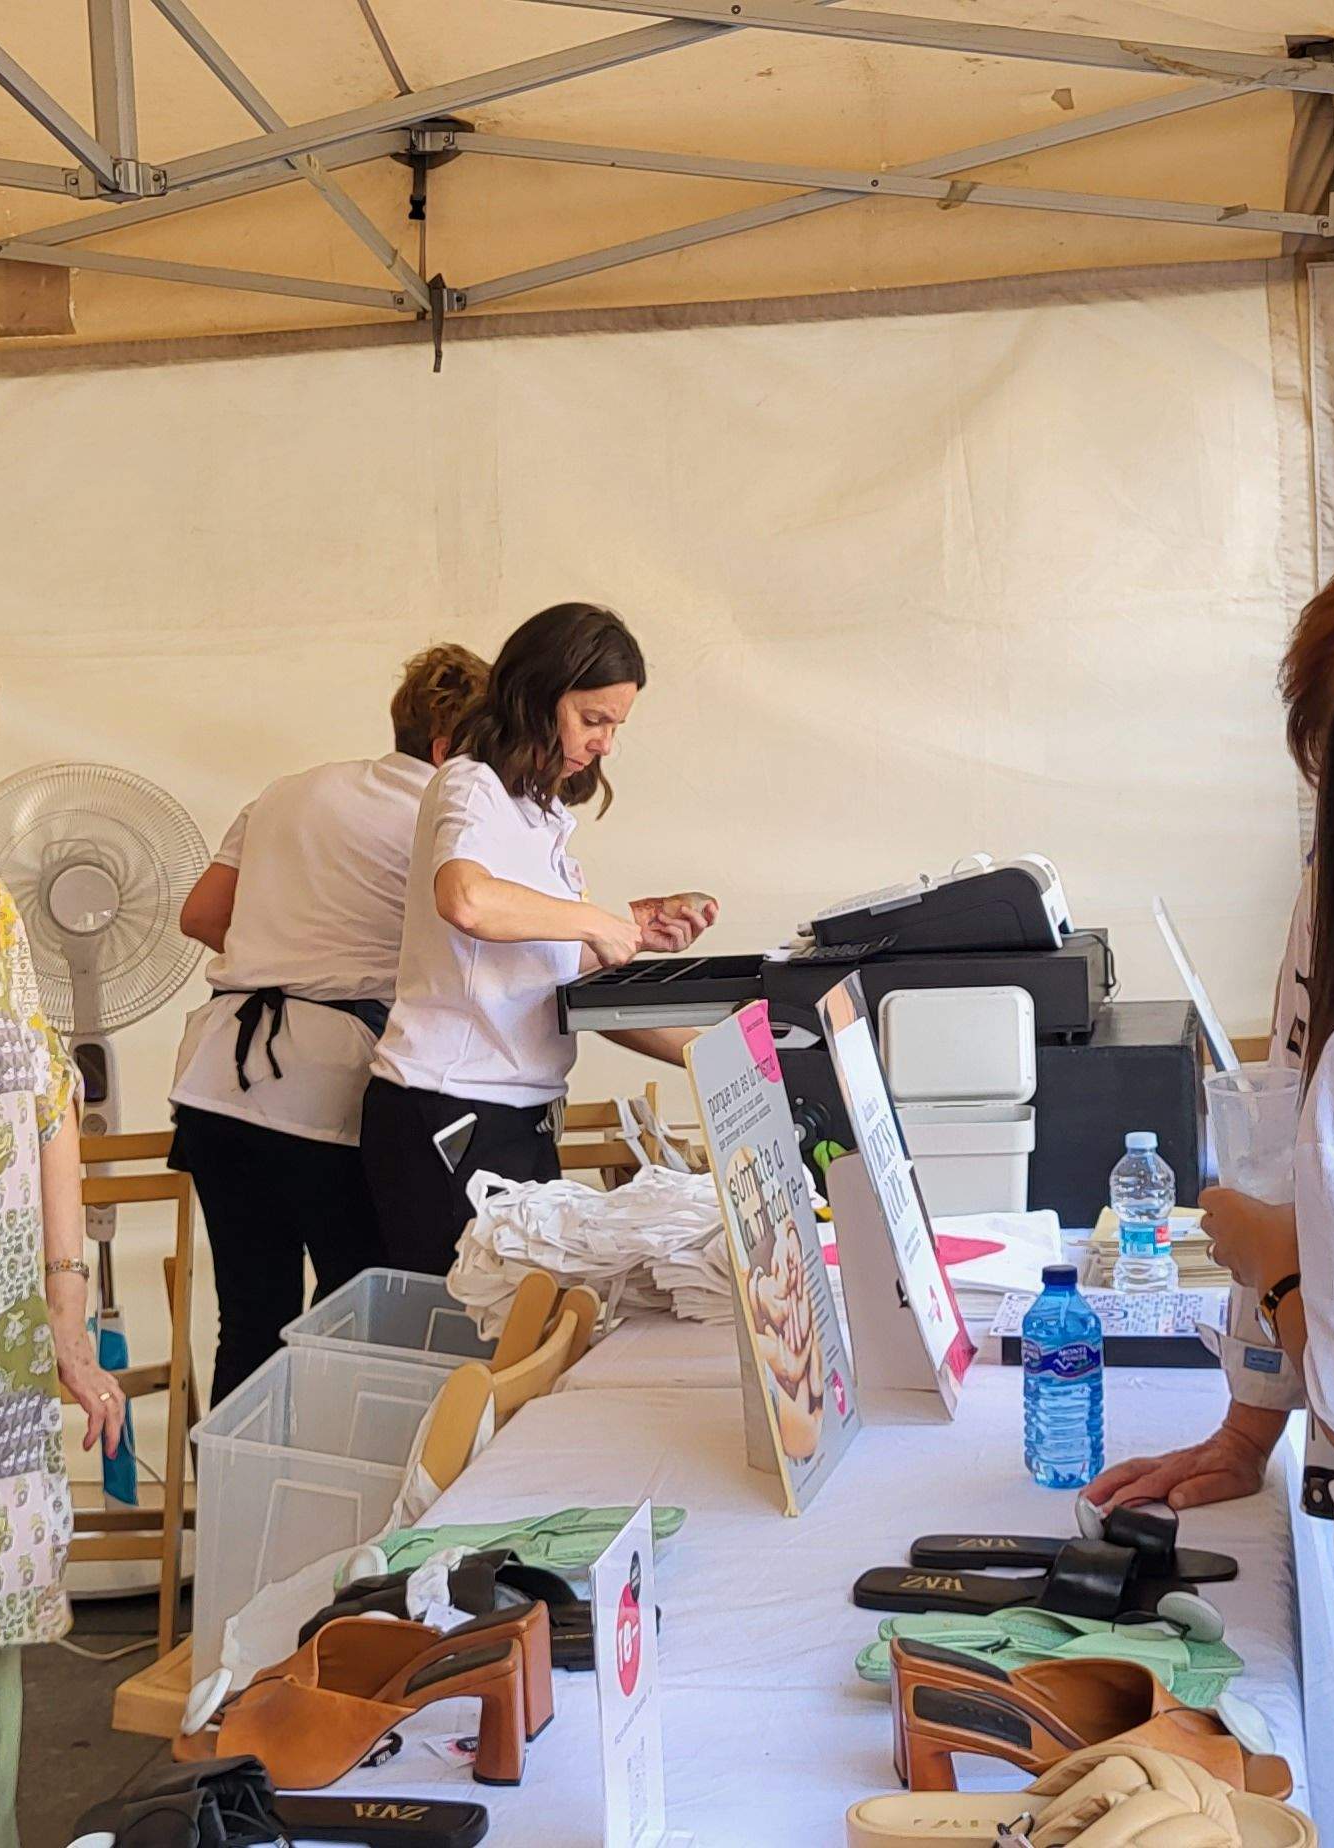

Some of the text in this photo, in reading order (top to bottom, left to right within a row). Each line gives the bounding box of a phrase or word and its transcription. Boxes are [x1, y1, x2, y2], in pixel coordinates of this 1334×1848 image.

[729, 1139, 784, 1209] súmate a
[957, 1537, 1018, 1549] ZARA
[899, 1574, 965, 1592] ZARA
[351, 1802, 431, 1821] ZARA
